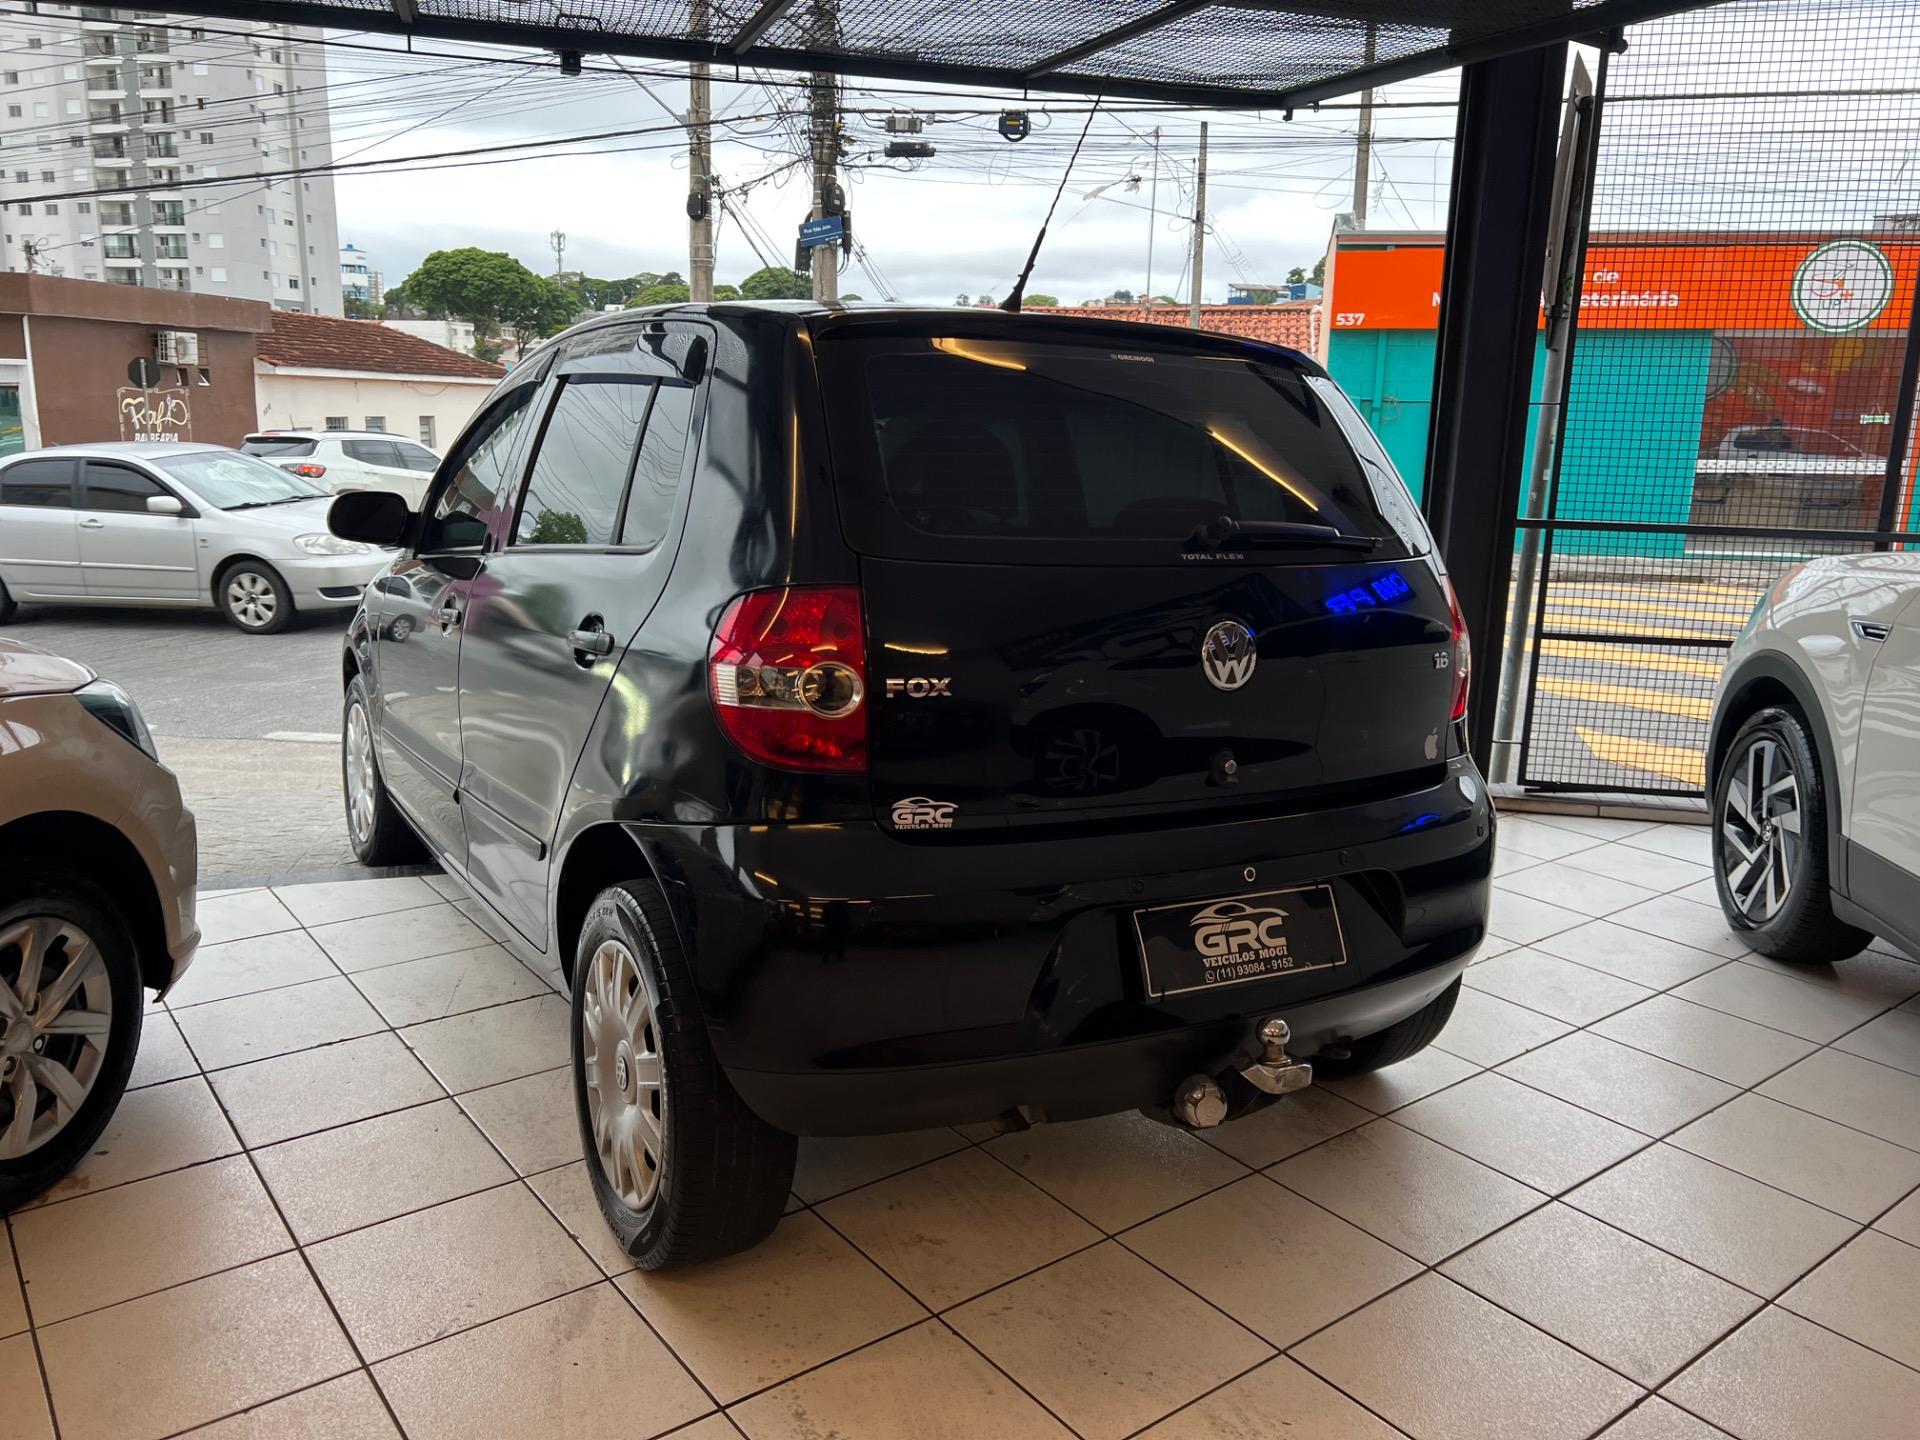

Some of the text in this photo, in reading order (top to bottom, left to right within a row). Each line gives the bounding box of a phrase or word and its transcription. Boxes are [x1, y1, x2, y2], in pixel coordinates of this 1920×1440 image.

[1593, 268, 1619, 283] de
[1580, 290, 1679, 307] eterinária
[1335, 313, 1365, 326] 537
[885, 677, 952, 698] FOX
[892, 807, 954, 825] GRC
[931, 822, 953, 830] MOGI
[1195, 917, 1287, 956] GRC
[1203, 945, 1288, 967] VEICULOS MOGI
[1216, 967, 1236, 982] (11)
[1237, 960, 1266, 977] 93084
[1272, 956, 1294, 971] 9152
